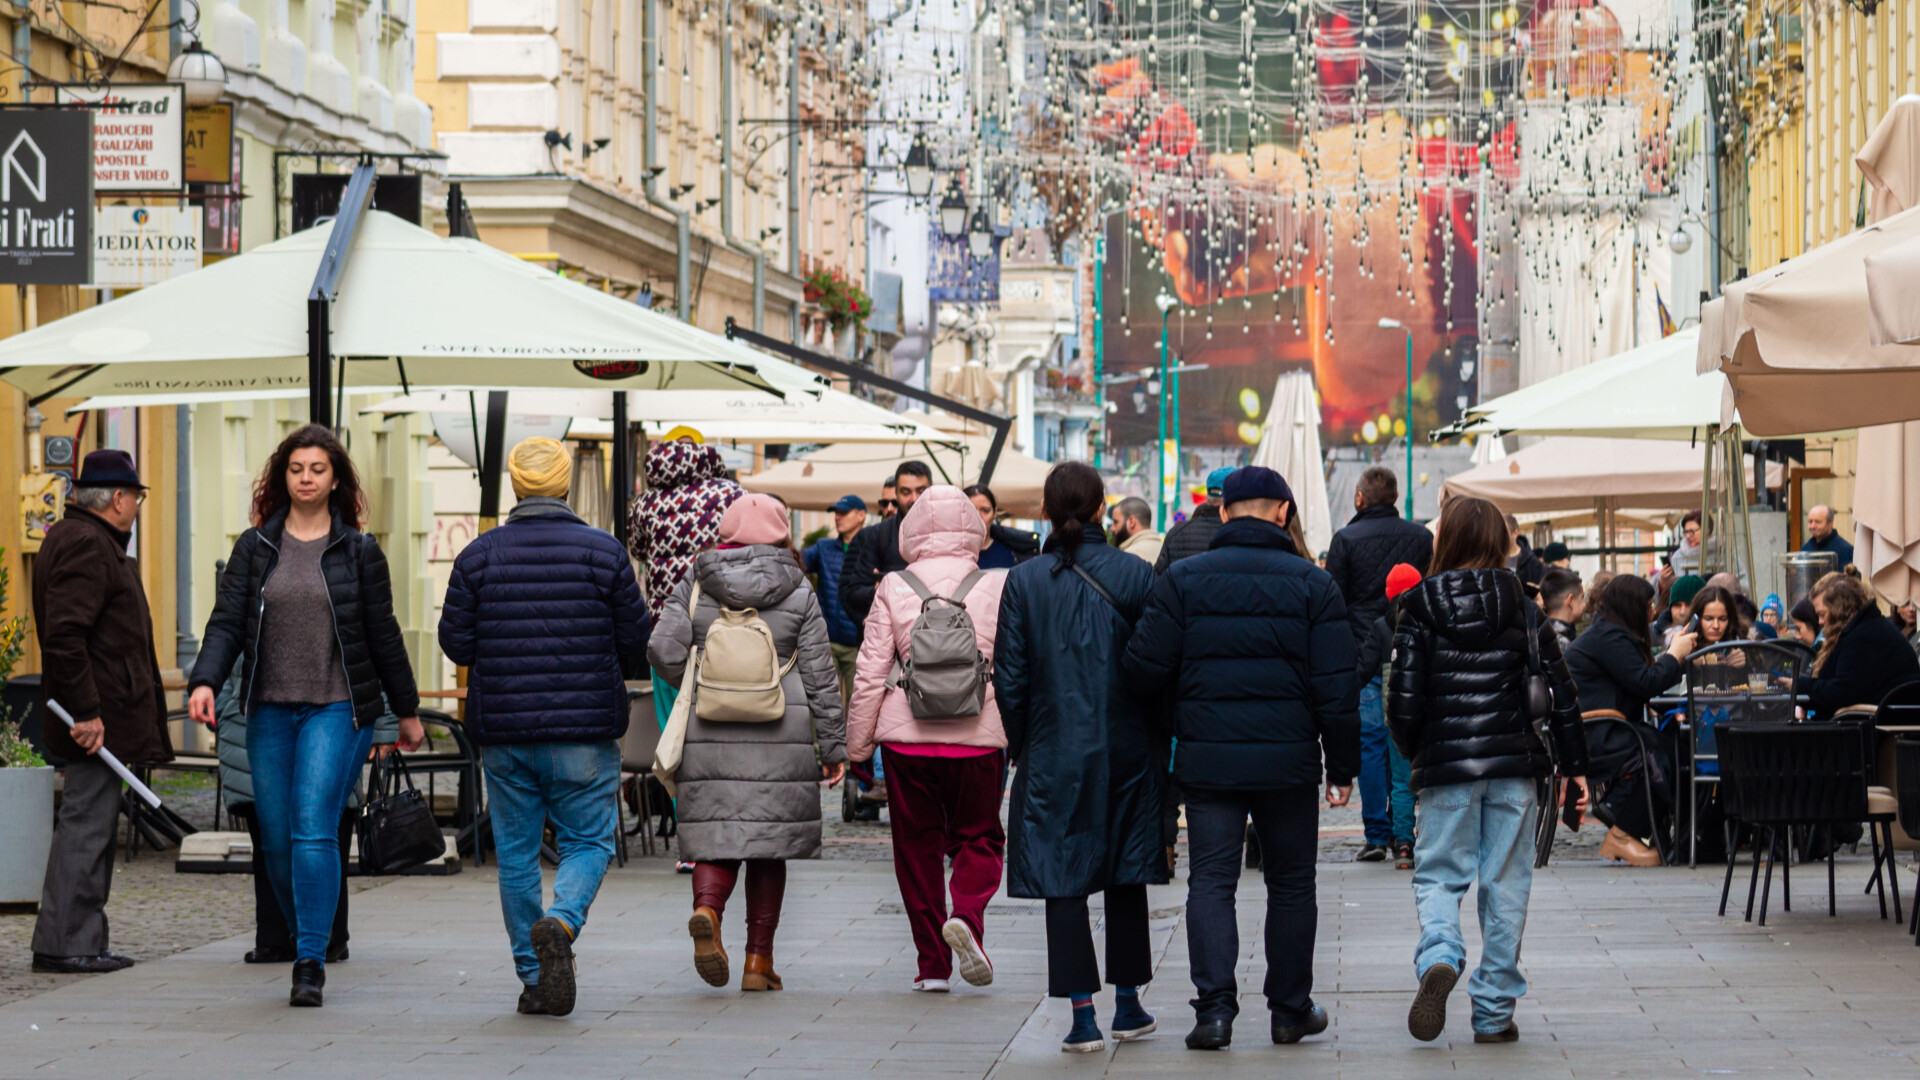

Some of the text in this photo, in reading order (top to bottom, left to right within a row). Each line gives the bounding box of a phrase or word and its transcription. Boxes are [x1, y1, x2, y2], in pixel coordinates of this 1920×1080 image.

[94, 125, 153, 135] RADUCERI
[94, 138, 153, 151] EGALIZĂRI
[185, 129, 208, 149] AT
[94, 170, 169, 181] NSFER VIDEO
[0, 208, 75, 248] i Frati
